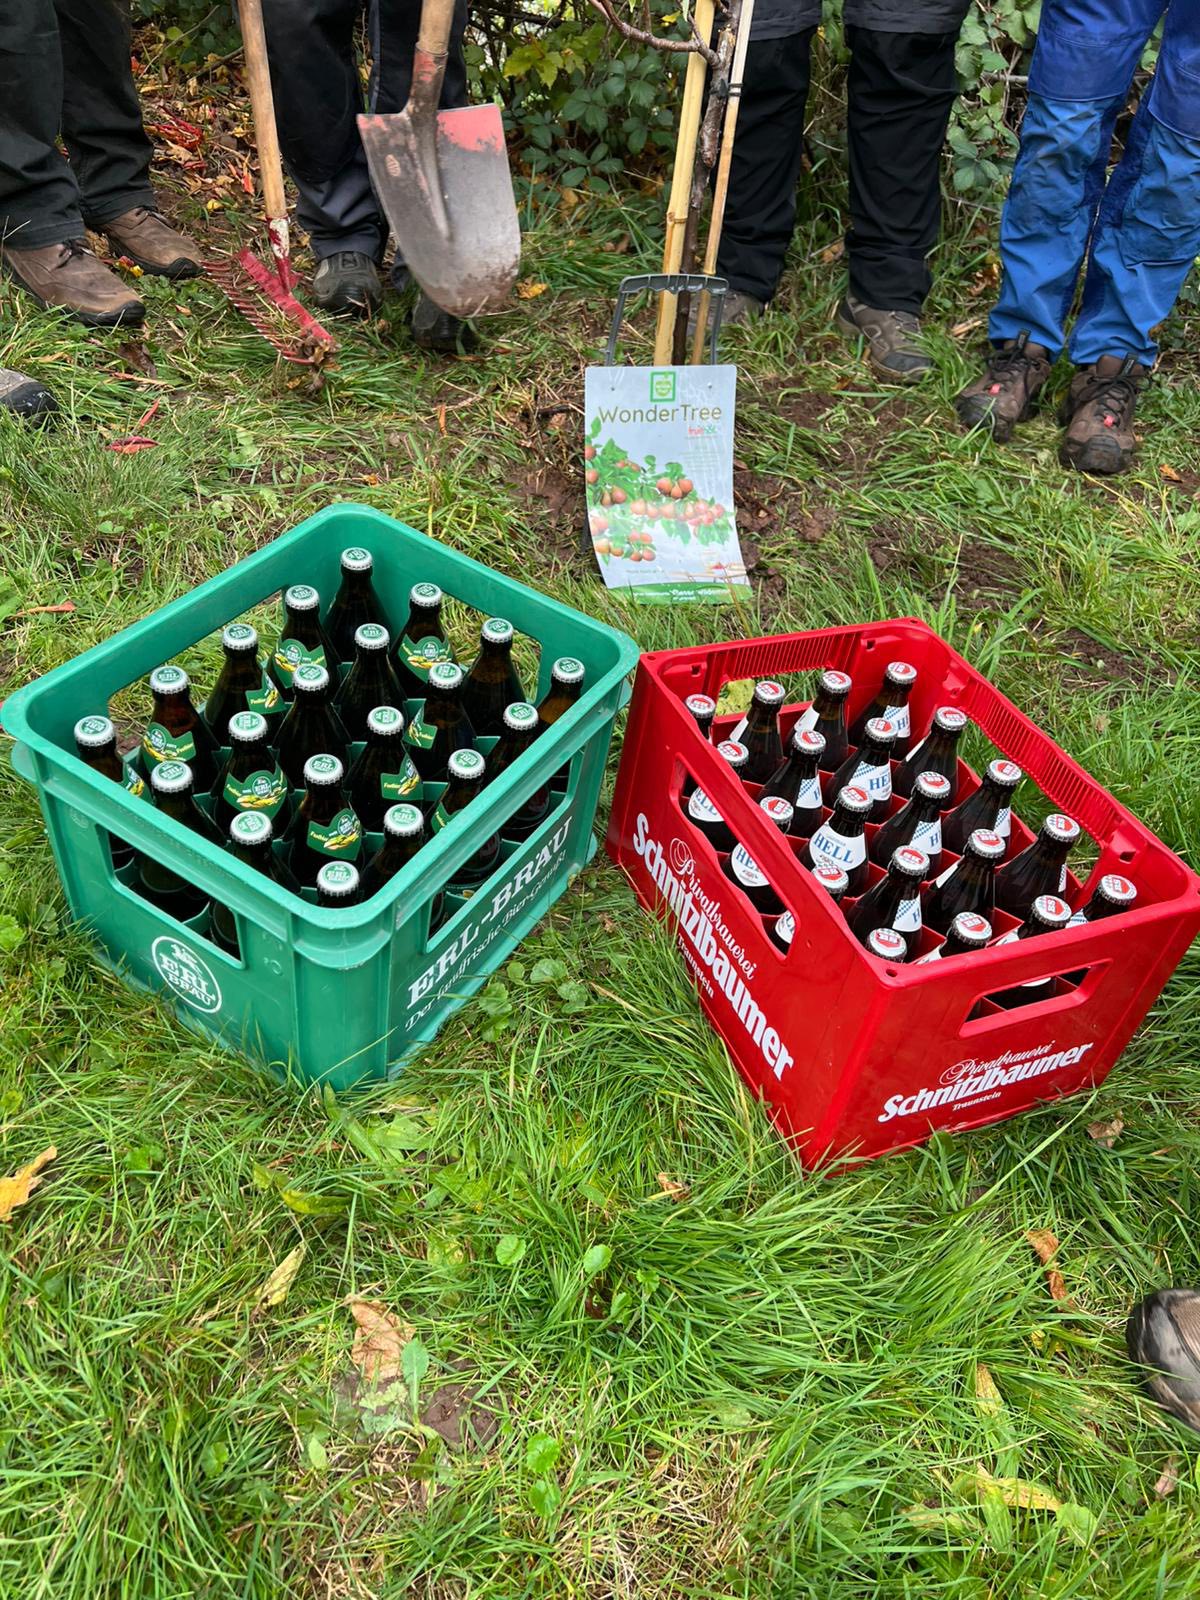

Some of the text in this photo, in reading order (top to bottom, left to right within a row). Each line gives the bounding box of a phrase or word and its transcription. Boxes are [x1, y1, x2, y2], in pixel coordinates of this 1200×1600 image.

[598, 404, 722, 423] WonderTree
[869, 774, 891, 790] HE
[736, 847, 760, 872] HE
[813, 832, 854, 864] HELL
[670, 838, 757, 980] Privatbrauerei
[633, 812, 794, 1082] Schnitzlbaumer
[160, 953, 216, 1002] ERL
[405, 1000, 437, 1032] Der
[939, 1040, 1056, 1086] Privatbrauerei
[877, 1042, 1094, 1123] Schnitzlbaumer
[952, 1090, 1002, 1112] Traunstein
